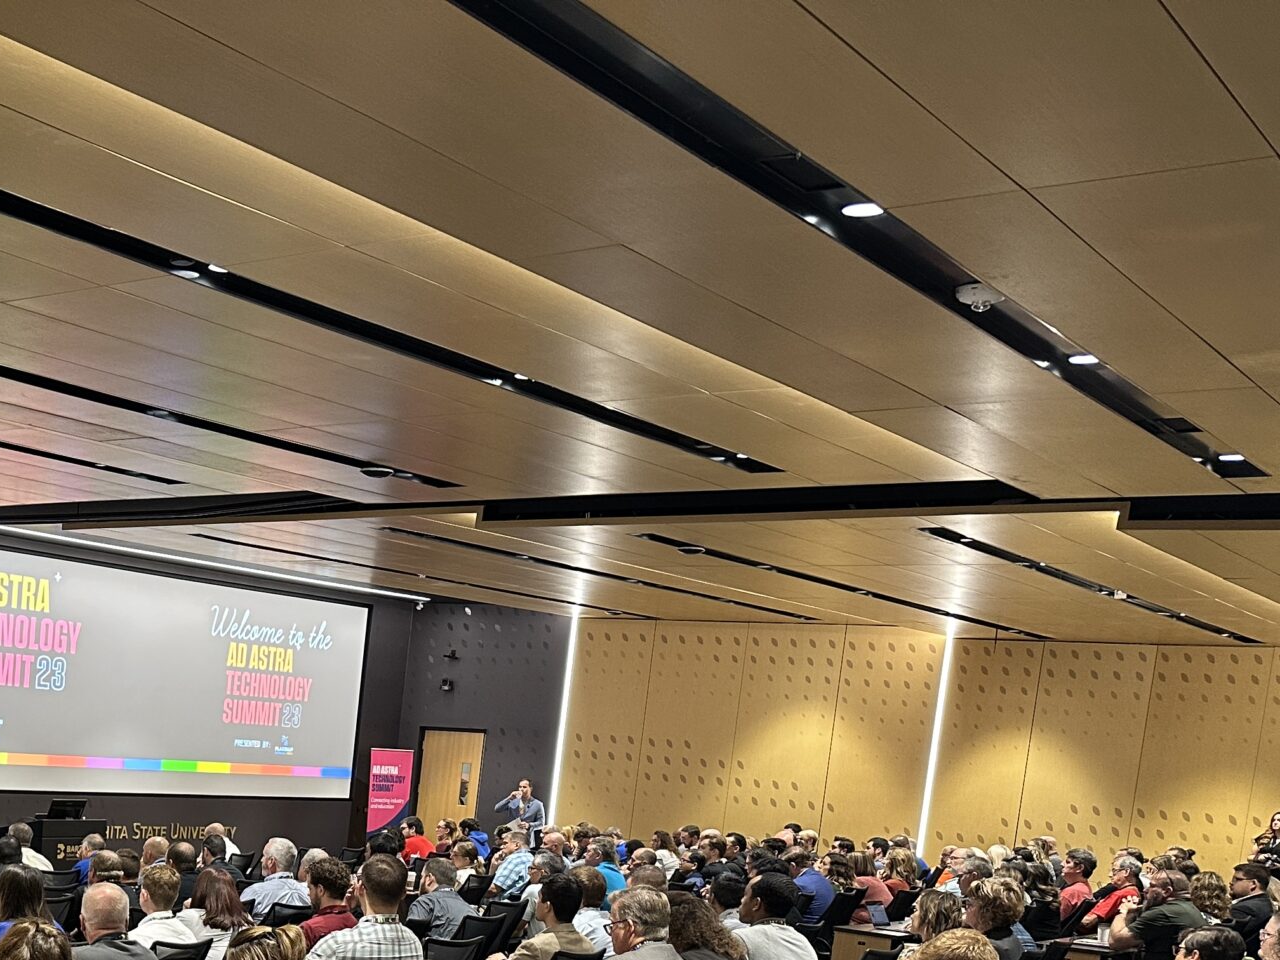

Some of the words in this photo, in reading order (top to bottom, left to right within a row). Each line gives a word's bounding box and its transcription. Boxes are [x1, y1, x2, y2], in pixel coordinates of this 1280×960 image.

[211, 604, 285, 644] Welcome
[288, 623, 305, 647] to
[308, 620, 333, 650] the
[226, 641, 248, 668] AD
[249, 644, 294, 673] ASTRA
[226, 669, 312, 702] TECHNOLOGY
[372, 765, 381, 774] AD
[381, 765, 399, 775] ASTRA
[372, 774, 406, 784] TECHNOLOGY
[371, 783, 394, 792] SUMMIT
